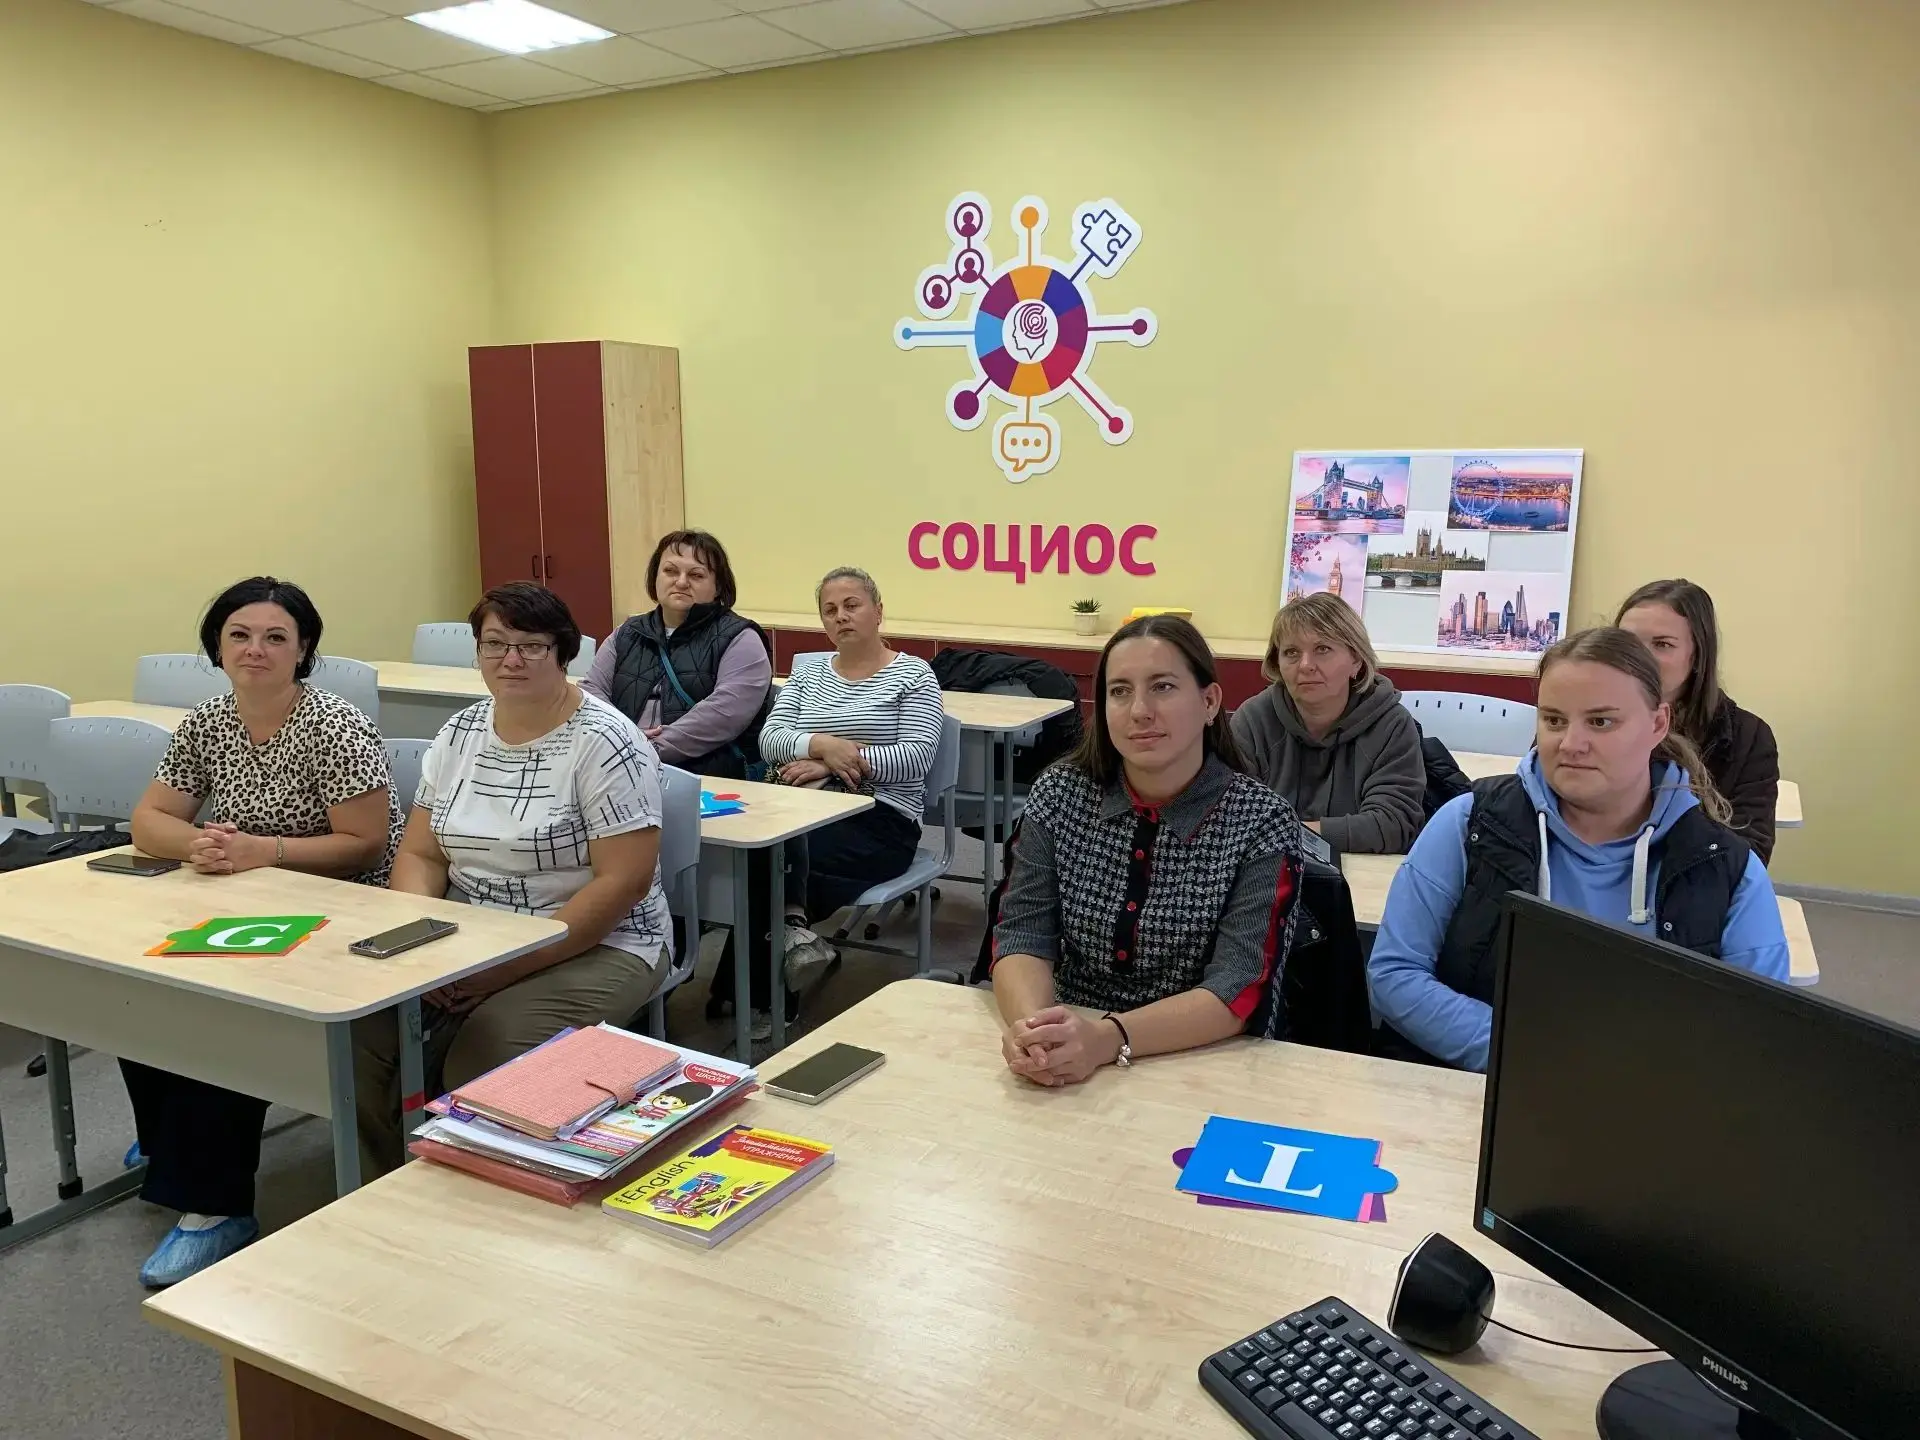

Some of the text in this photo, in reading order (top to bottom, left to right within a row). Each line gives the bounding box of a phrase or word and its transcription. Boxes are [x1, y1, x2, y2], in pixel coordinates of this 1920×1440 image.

[908, 521, 1157, 584] СОЦИОС
[206, 923, 292, 948] G
[696, 1071, 727, 1084] ШКОЛА
[742, 1145, 805, 1164] УПРАЖНЕНИЯ
[1224, 1140, 1324, 1199] T
[621, 1160, 695, 1201] English
[1702, 1355, 1748, 1391] PHILIPS
